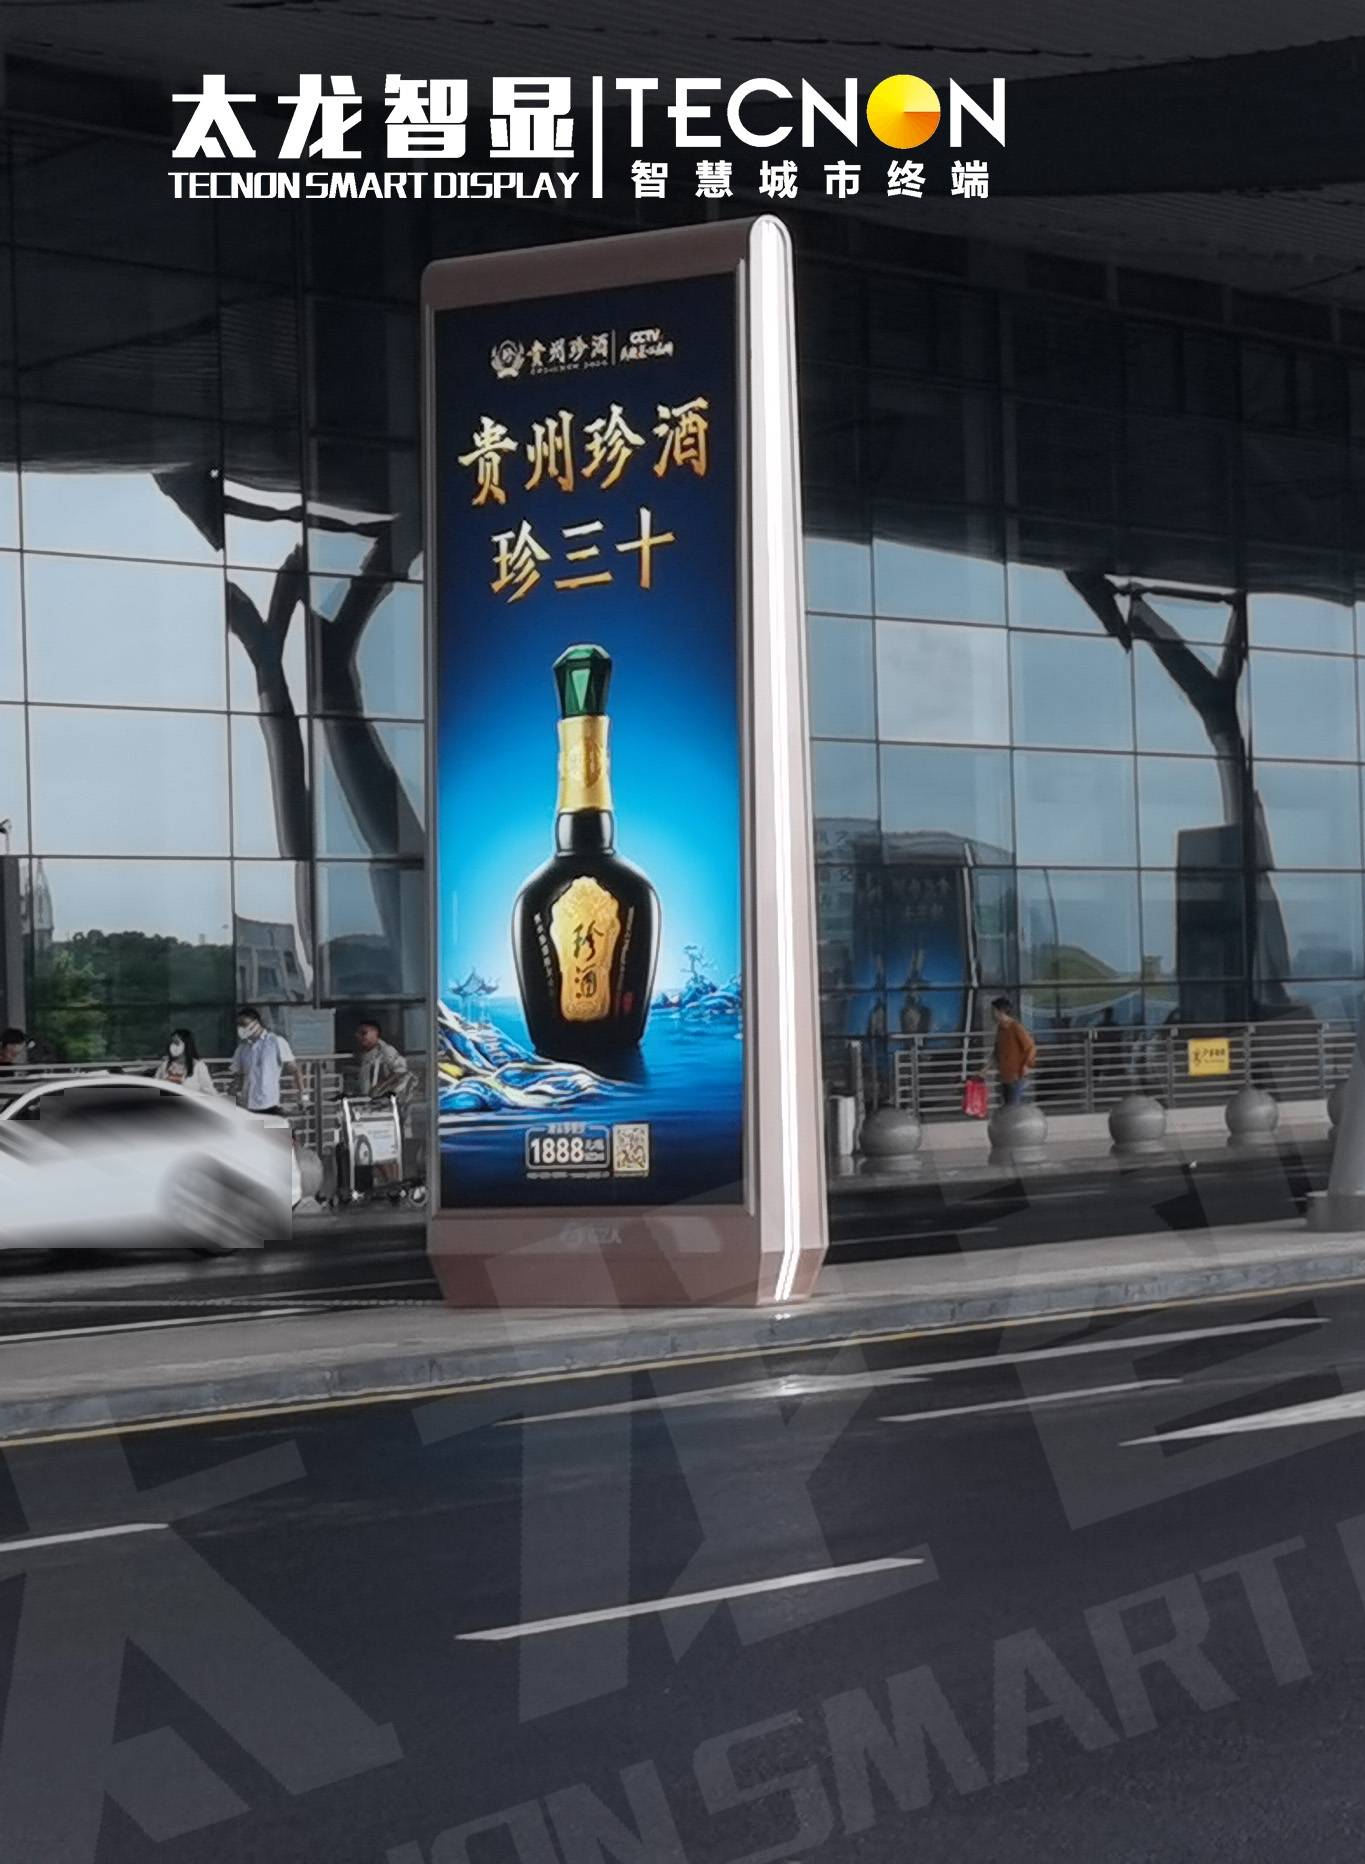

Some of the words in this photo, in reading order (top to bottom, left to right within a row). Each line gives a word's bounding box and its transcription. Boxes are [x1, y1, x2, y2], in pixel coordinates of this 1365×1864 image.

[457, 397, 709, 505] 贵州珍酒
[490, 506, 677, 603] 珍三十
[530, 1137, 585, 1164] 1888
